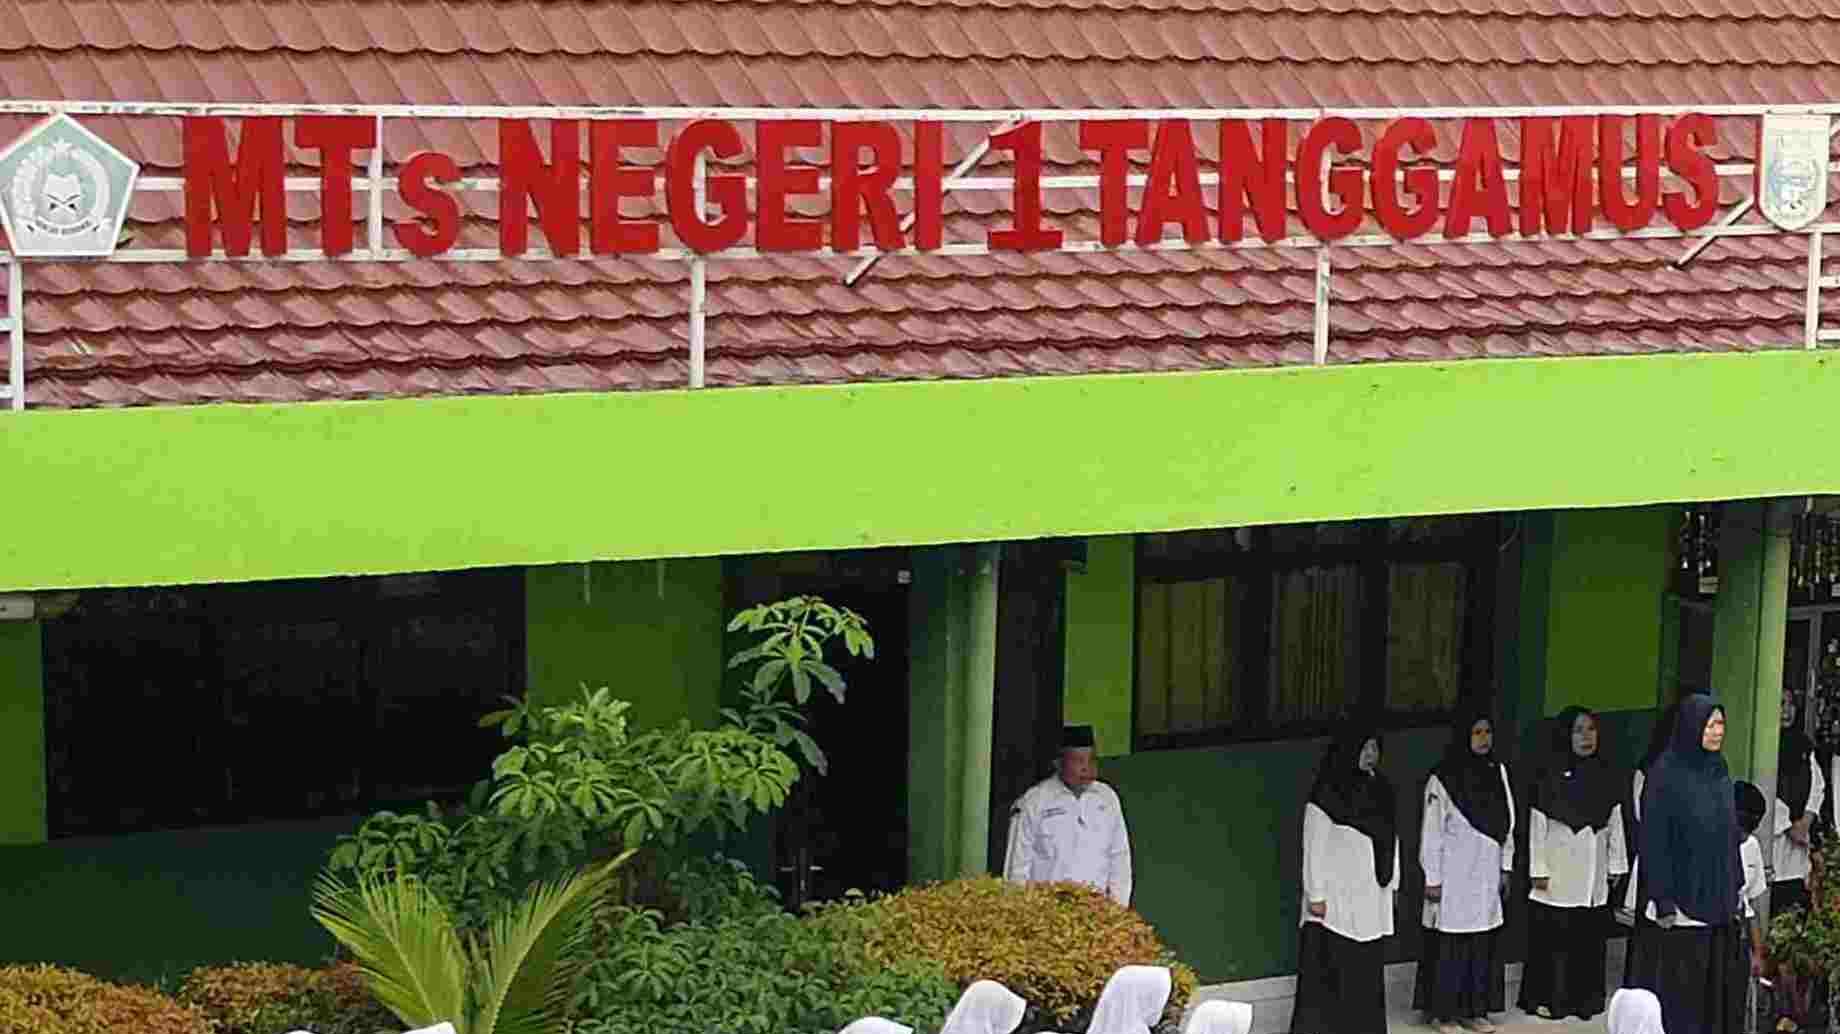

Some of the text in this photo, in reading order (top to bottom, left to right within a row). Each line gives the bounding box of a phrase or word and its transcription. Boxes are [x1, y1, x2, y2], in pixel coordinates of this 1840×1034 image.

[182, 112, 1719, 257] MTs NEGERI 1 TANGGAMUS
